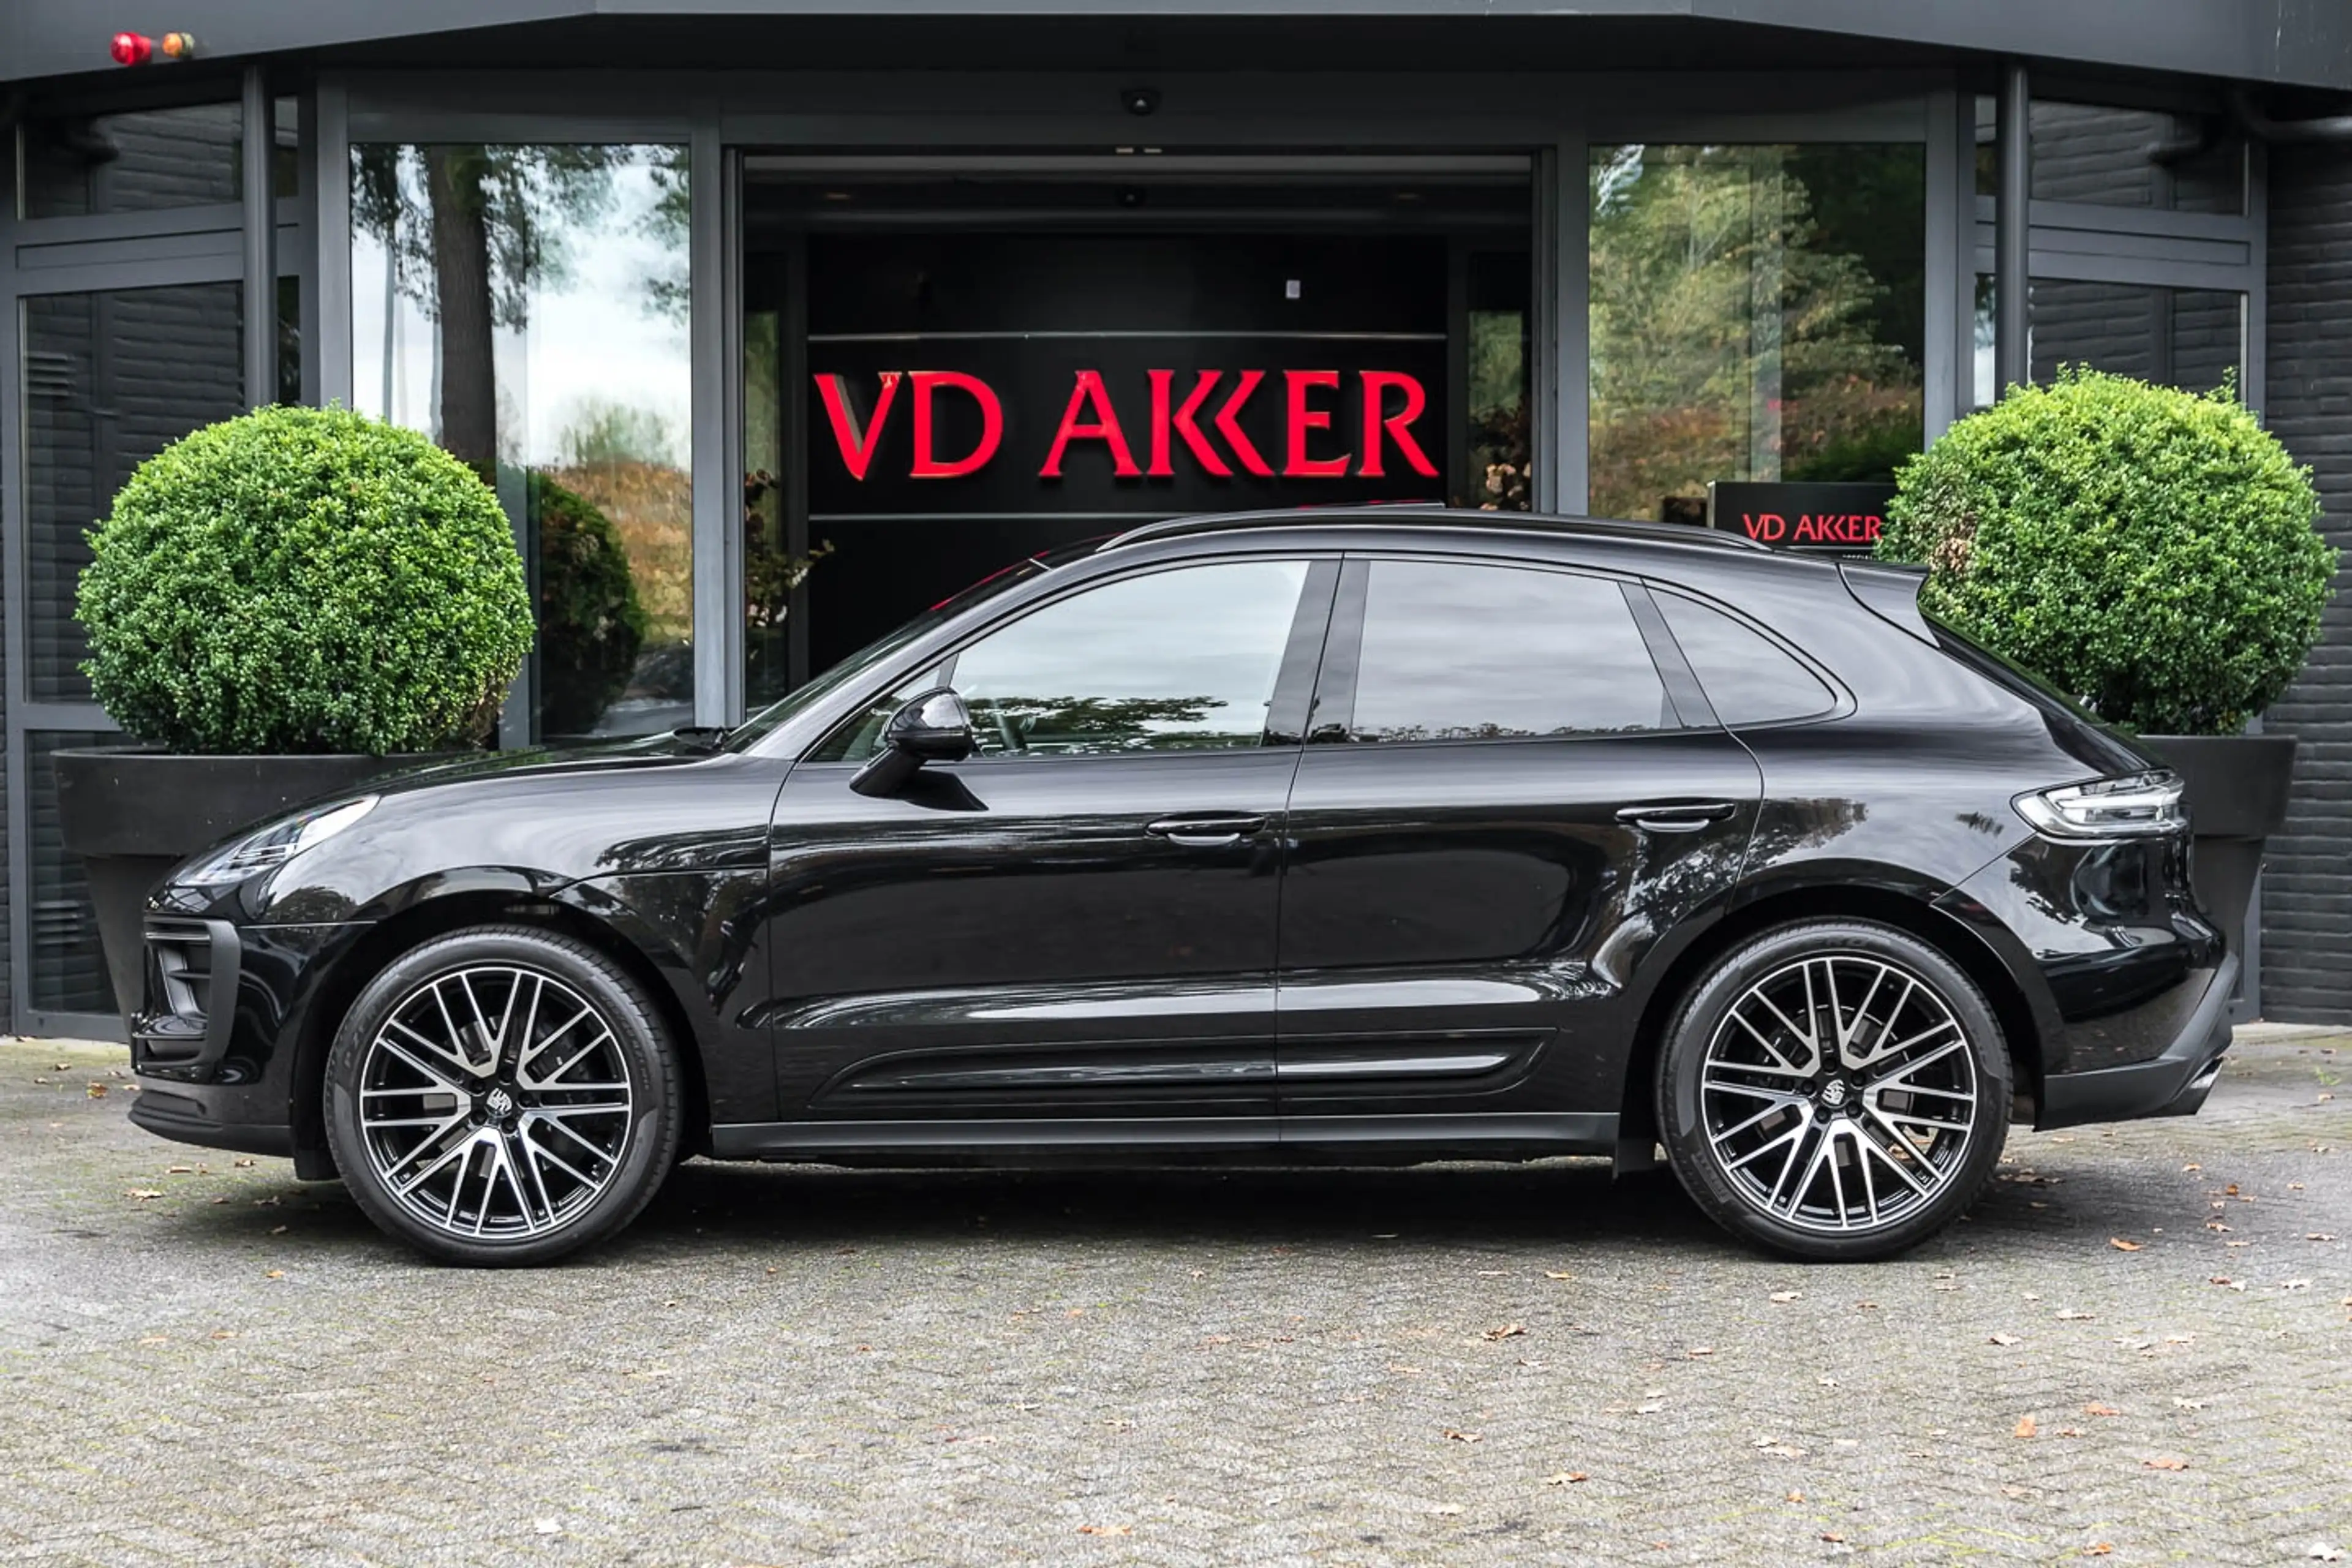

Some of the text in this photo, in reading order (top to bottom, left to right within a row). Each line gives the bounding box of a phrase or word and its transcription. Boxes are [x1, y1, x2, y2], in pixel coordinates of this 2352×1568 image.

[813, 369, 1439, 481] VD AKKER
[1743, 513, 1882, 541] VD AKKER
